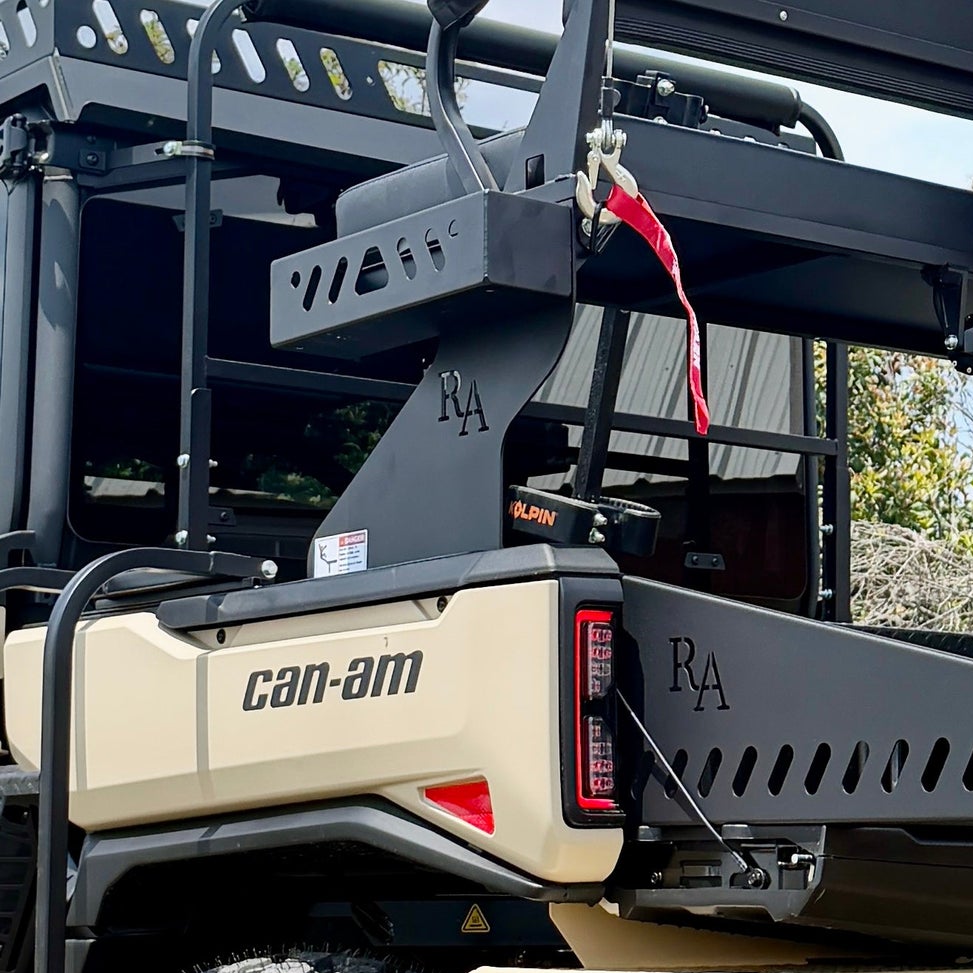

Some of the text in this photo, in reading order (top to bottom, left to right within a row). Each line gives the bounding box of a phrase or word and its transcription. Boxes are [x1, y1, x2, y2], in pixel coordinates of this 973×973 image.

[438, 370, 489, 436] RA
[242, 650, 424, 711] can-am
[668, 637, 730, 711] RA
